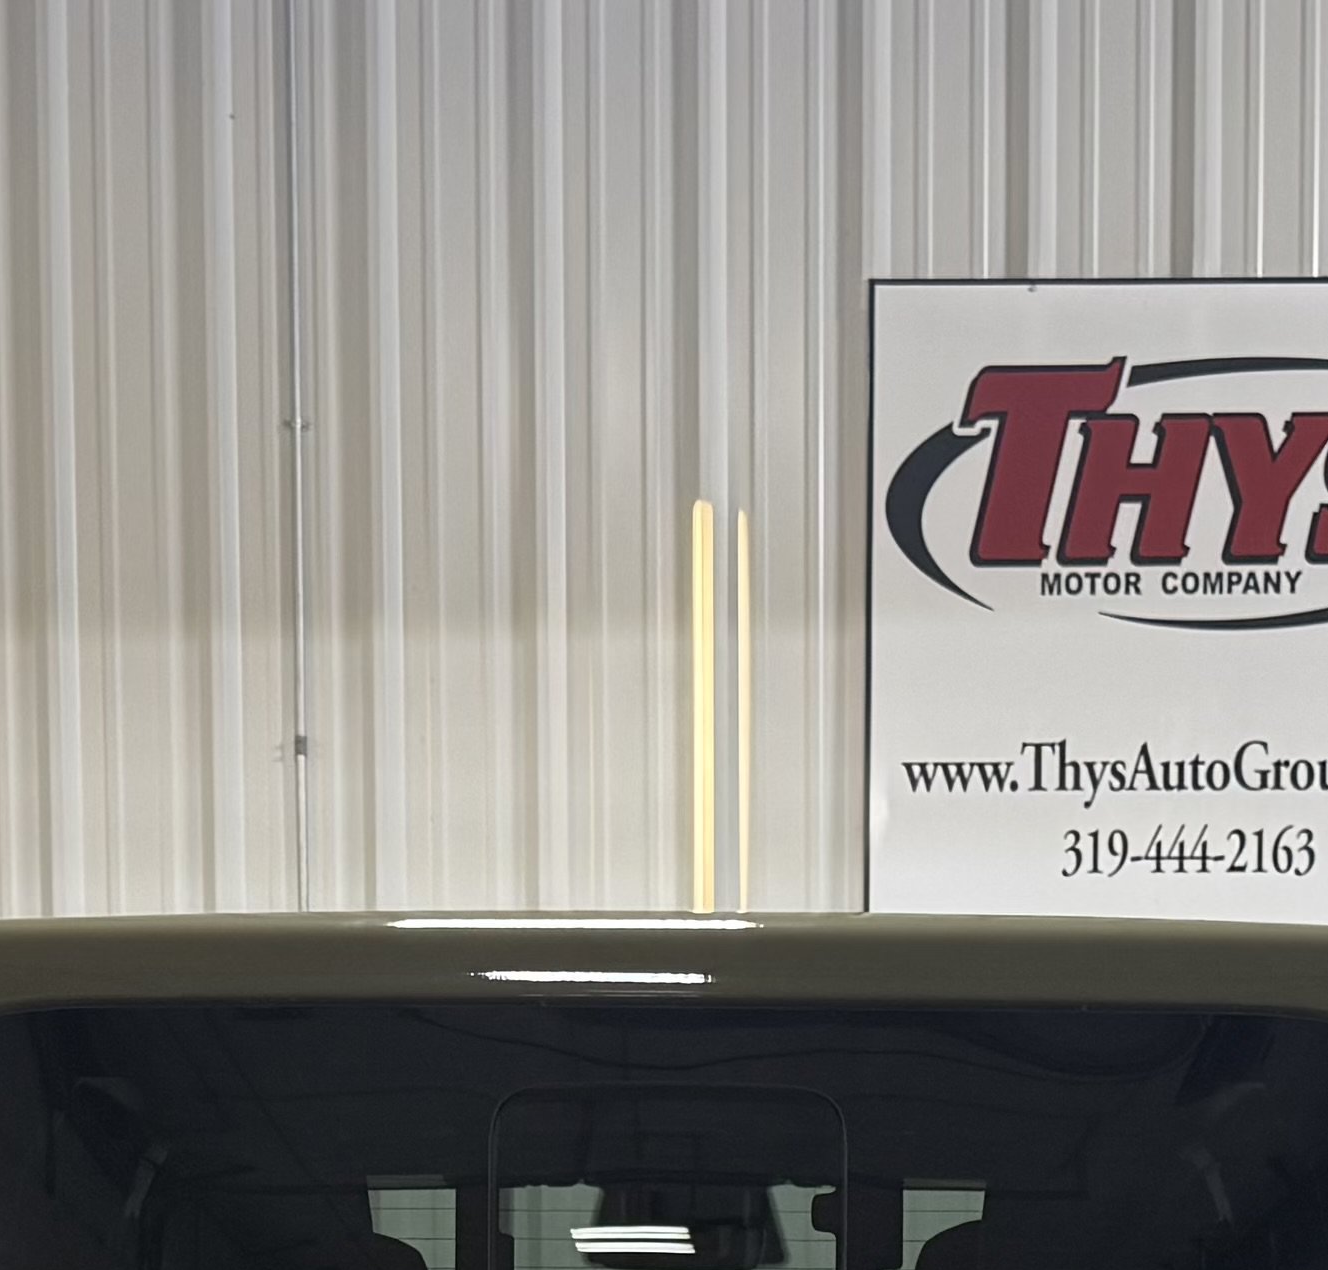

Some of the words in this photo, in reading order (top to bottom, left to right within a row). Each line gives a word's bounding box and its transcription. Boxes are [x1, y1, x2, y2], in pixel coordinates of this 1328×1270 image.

[1040, 571, 1142, 596] MOTOR
[1161, 570, 1303, 596] COMPANY
[1062, 824, 1316, 877] 319-444-2163
